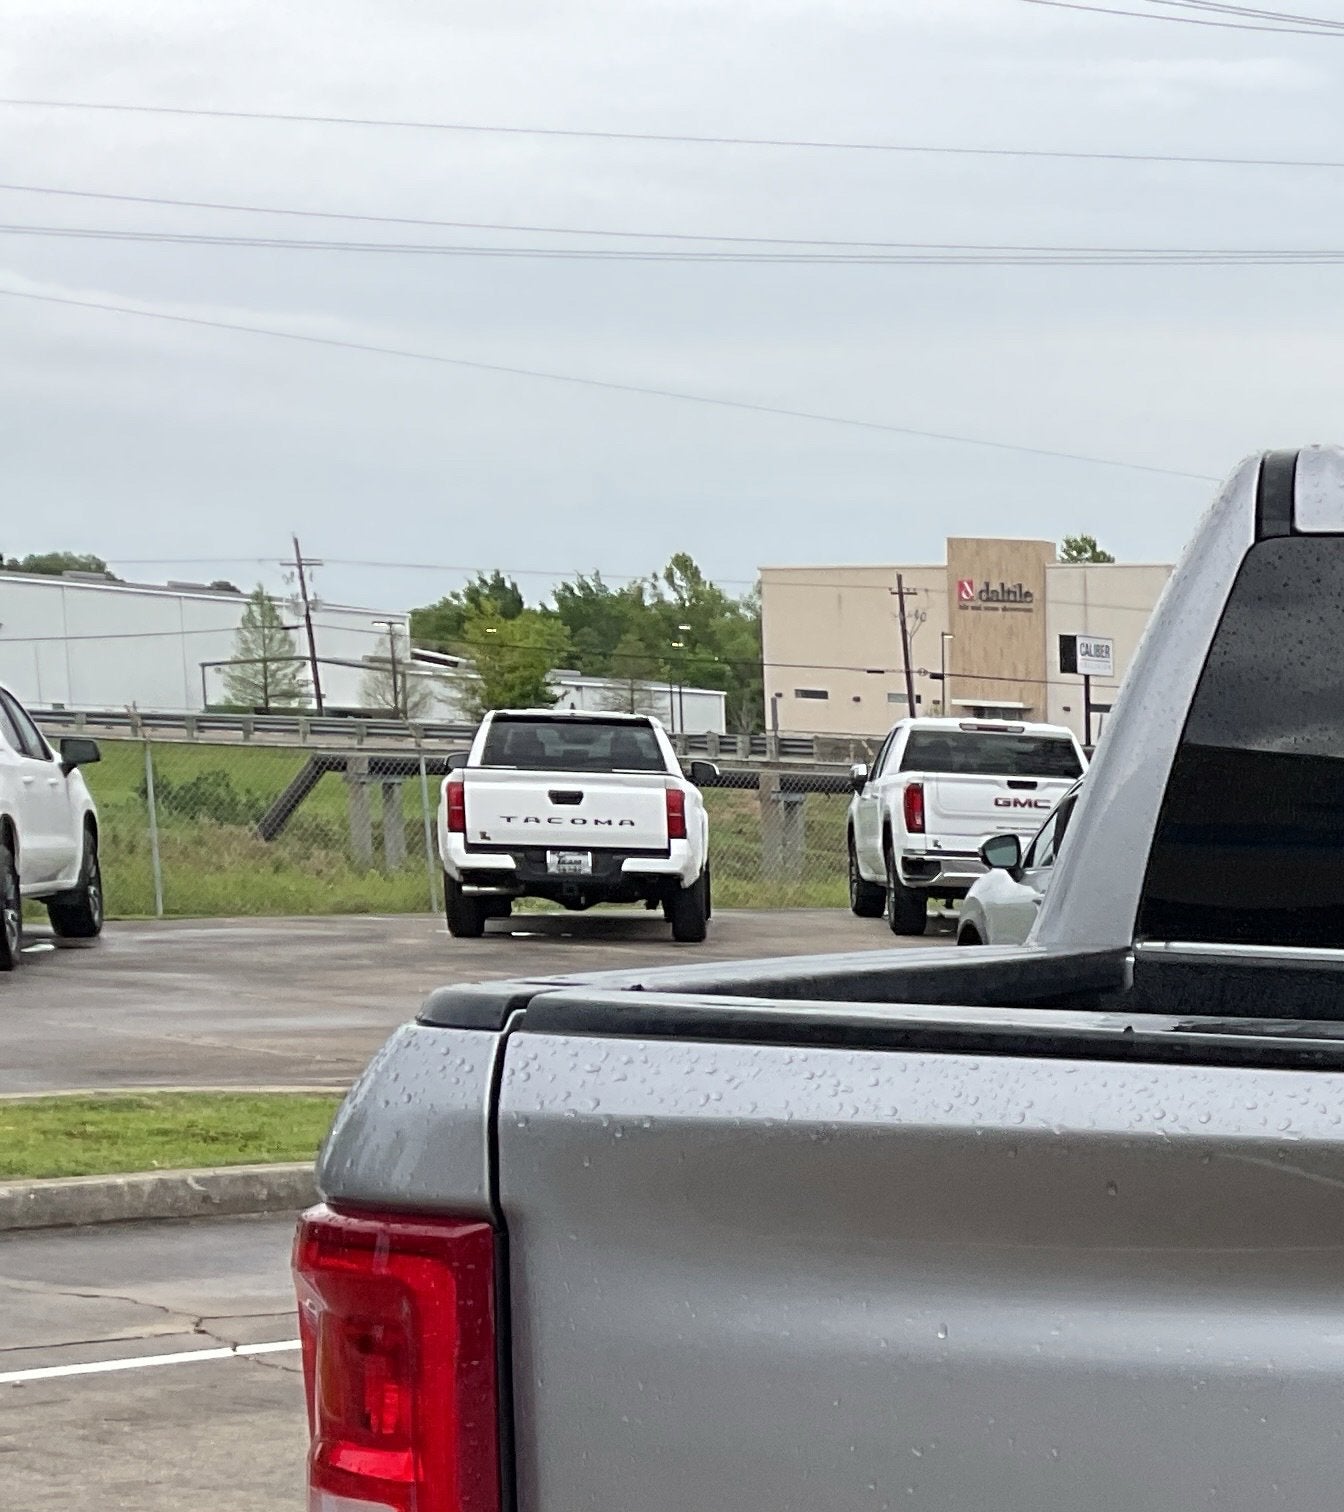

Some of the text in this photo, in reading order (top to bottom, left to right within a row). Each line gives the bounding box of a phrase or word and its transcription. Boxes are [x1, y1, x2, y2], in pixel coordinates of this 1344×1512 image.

[978, 582, 1033, 603] daltile
[1079, 642, 1111, 659] CALIBER
[994, 797, 1051, 809] GMC
[500, 815, 636, 827] TACOMA
